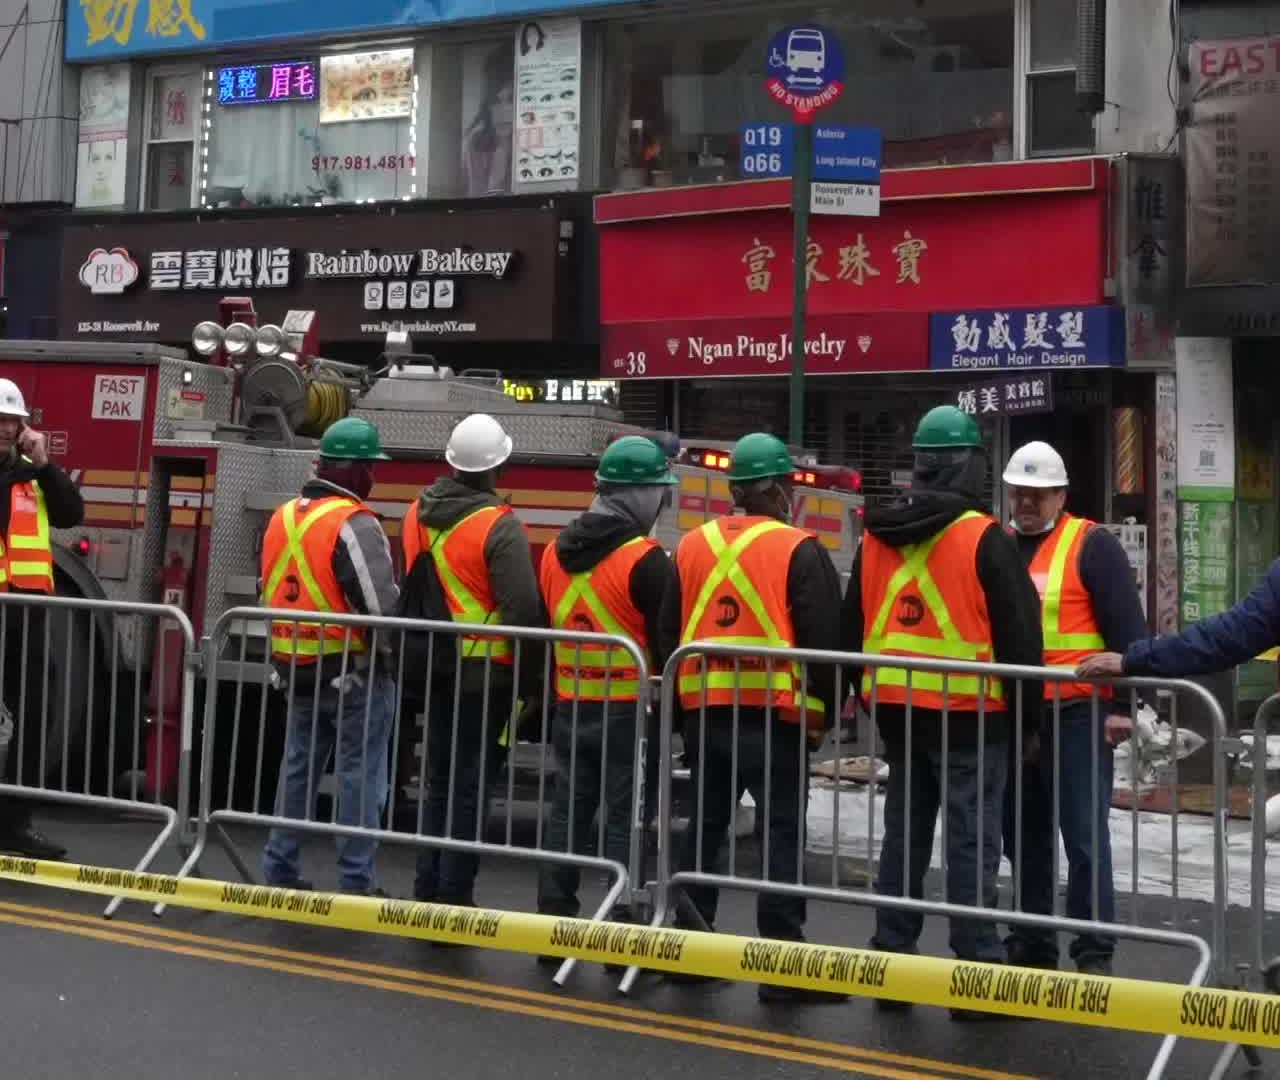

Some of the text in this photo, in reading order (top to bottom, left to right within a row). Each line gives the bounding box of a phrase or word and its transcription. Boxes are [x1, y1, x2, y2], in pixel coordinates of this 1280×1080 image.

[268, 64, 314, 98] 眉毛
[771, 82, 839, 111] NO STANDING
[745, 126, 782, 146] Q19
[744, 153, 782, 173] Q66
[815, 157, 834, 168] Long
[862, 157, 877, 169] City
[815, 185, 854, 197] Roosevelt
[150, 248, 291, 290] 雲寶烘焙
[306, 248, 512, 280] Rainbow Bakery
[951, 311, 1087, 353] 動感髮型
[626, 351, 647, 375] 38
[687, 336, 733, 365] Ngan
[736, 335, 778, 364] Ping
[951, 353, 1087, 370] Elegant Hair Design
[99, 378, 140, 395] FAST
[101, 401, 132, 417] PAK
[740, 941, 780, 973] CROSS
[779, 944, 805, 976] NOT
[806, 947, 827, 980] DO
[858, 953, 890, 987] FIRE
[949, 965, 993, 1000] CROSS
[993, 968, 1020, 1003] NOT
[1022, 971, 1043, 1006] DO
[1080, 979, 1112, 1015] FIRE
[1180, 991, 1228, 1030] CROSS
[1229, 996, 1260, 1033] NOT
